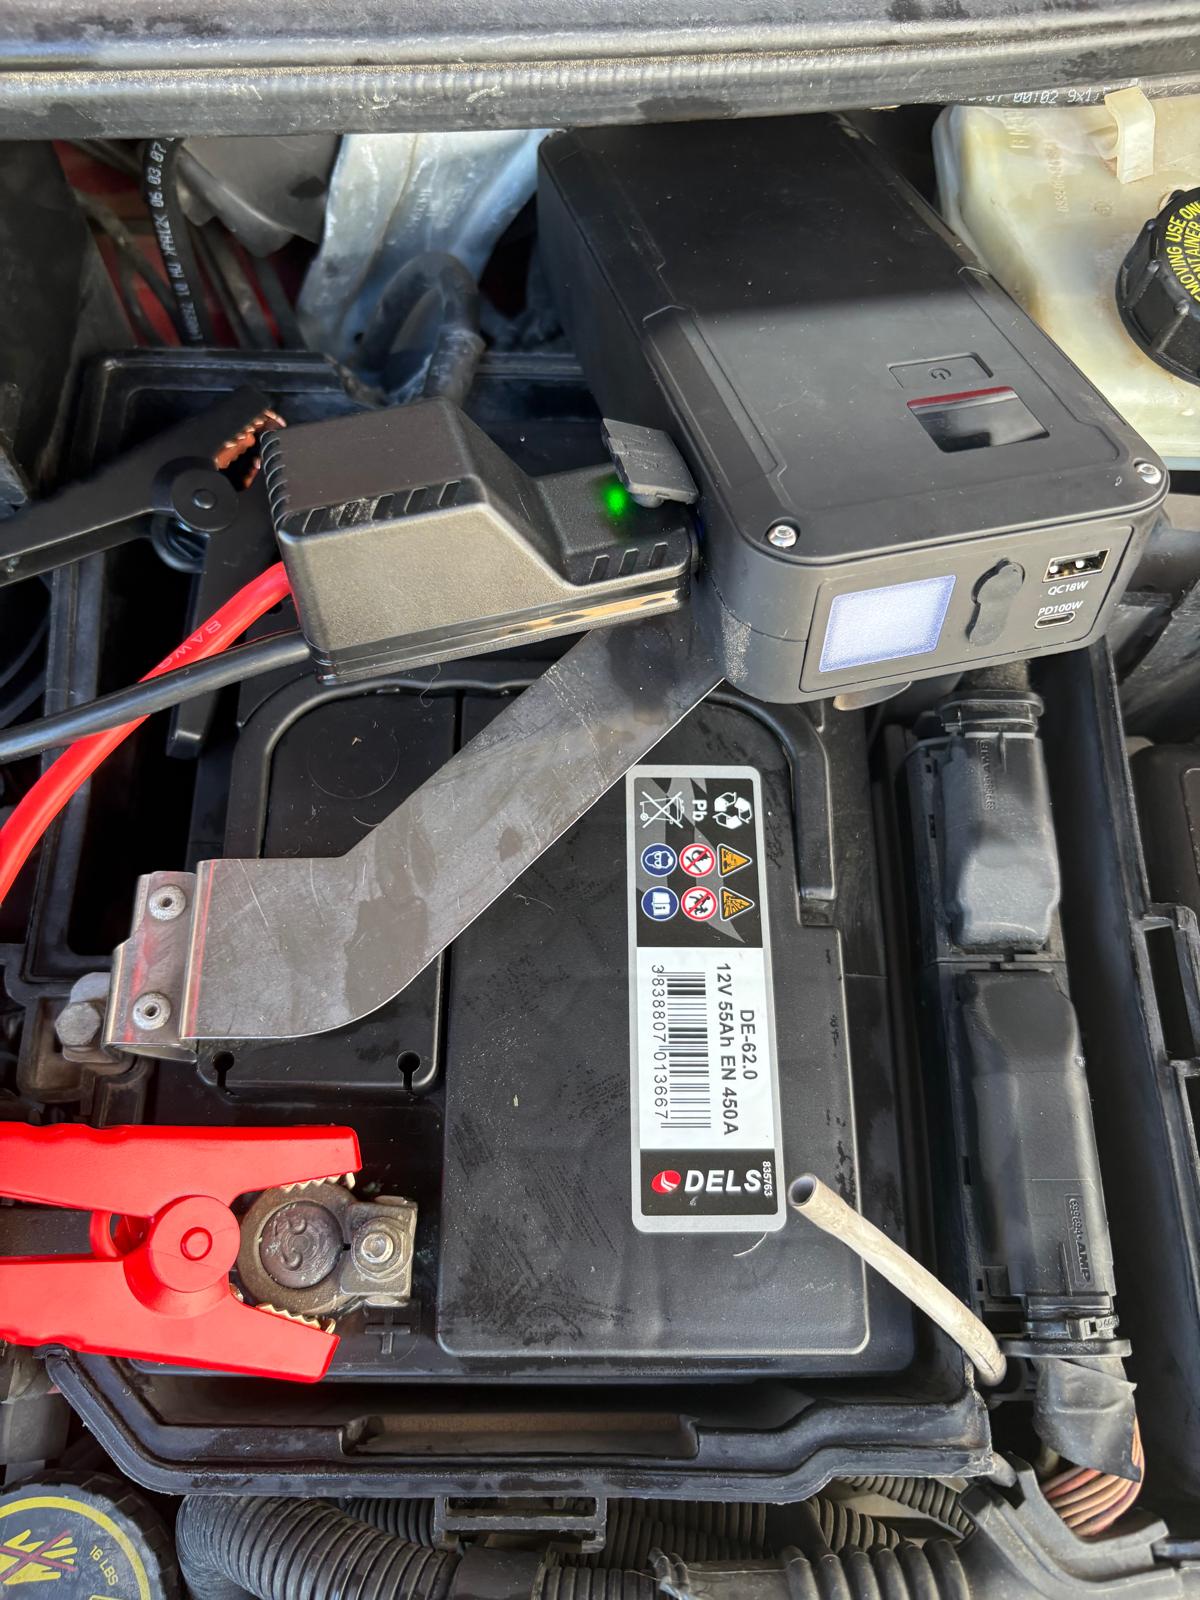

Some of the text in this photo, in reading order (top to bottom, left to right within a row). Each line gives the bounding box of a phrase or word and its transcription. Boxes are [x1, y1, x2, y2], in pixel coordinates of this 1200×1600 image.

[147, 142, 167, 207] 06.03.07
[1165, 215, 1187, 242] USE
[1047, 580, 1089, 596] QC18W
[1037, 600, 1084, 616] PD100W
[691, 799, 707, 822] Pb
[716, 963, 739, 1136] 12V 55Ah EN 450A
[739, 1009, 758, 1081] DE-62.0
[684, 1169, 763, 1192] DELS
[762, 1160, 773, 1197] 835763
[89, 1545, 119, 1586] 16 LBS
